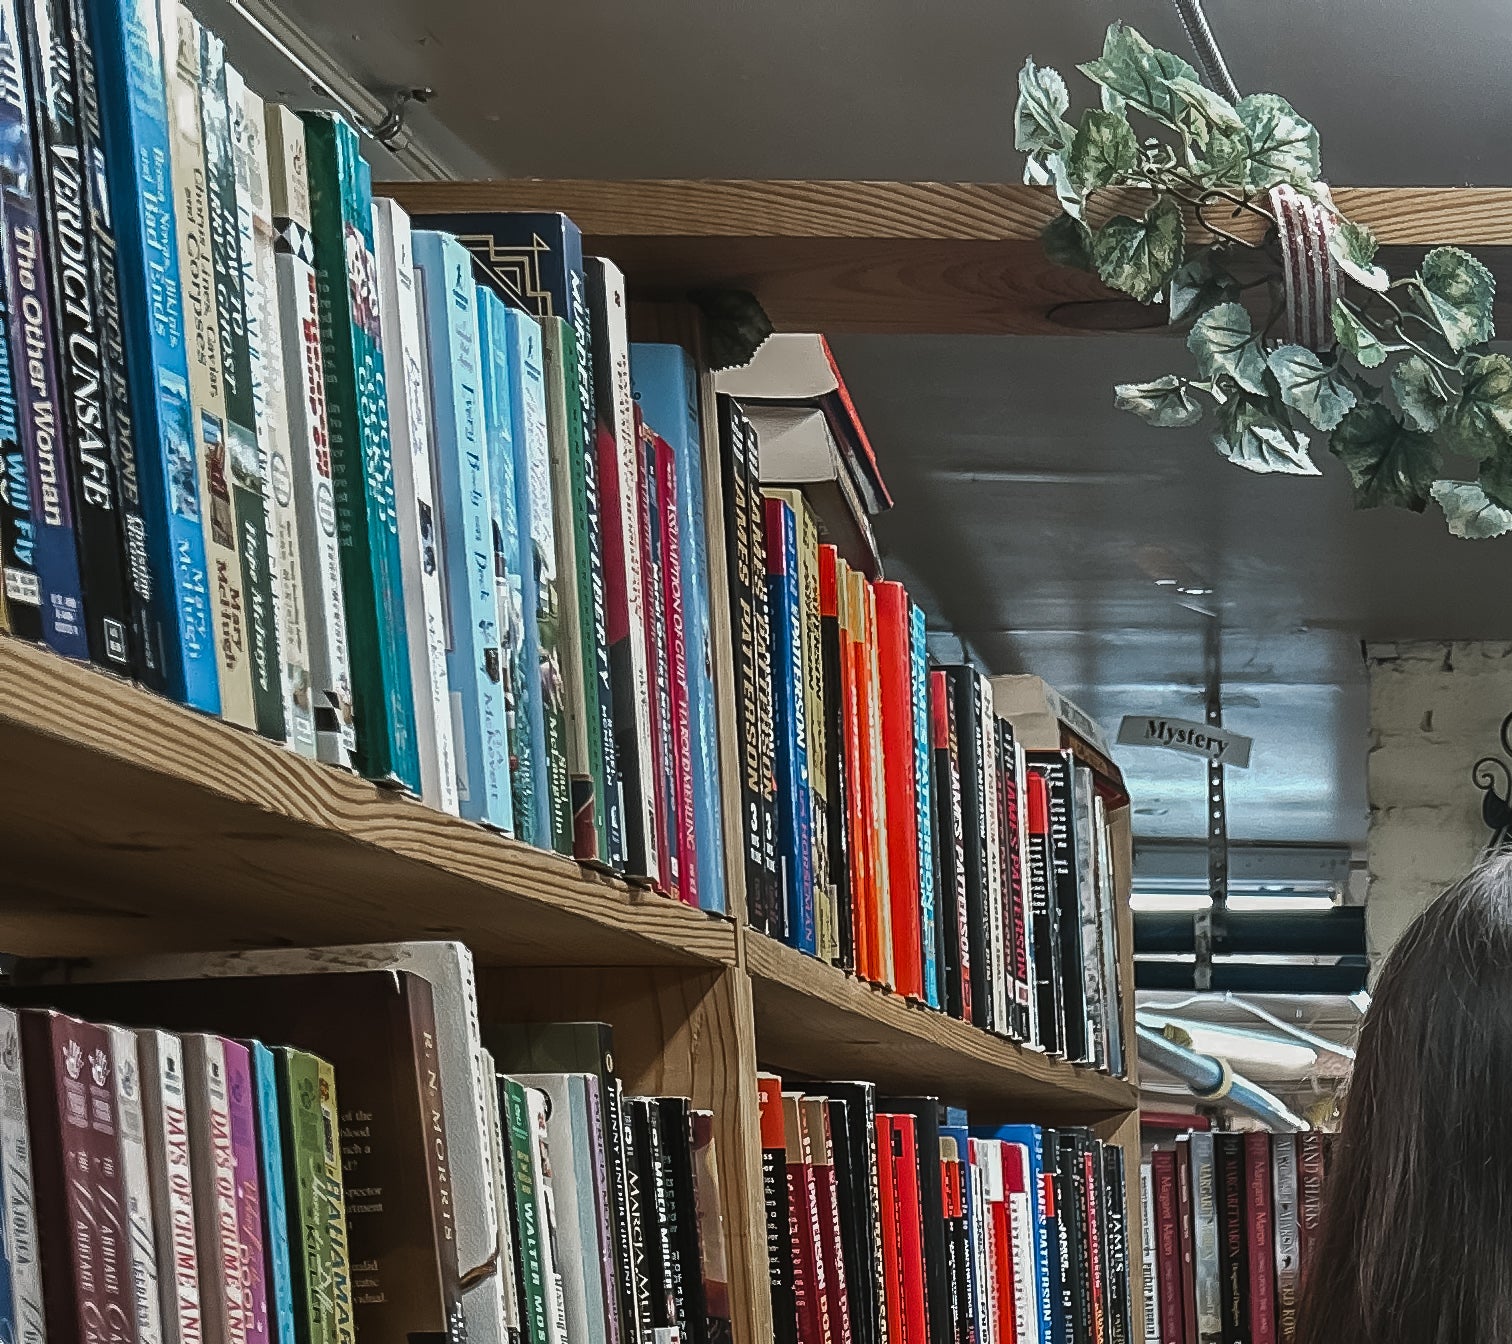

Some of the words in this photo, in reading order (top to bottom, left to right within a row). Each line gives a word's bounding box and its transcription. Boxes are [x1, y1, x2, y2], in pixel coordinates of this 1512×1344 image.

[14, 226, 39, 291] The
[50, 144, 97, 332] VERDICT
[22, 295, 49, 397] Other
[69, 333, 113, 510] UNSAFE
[6, 454, 31, 511] Will
[32, 401, 63, 526] Woman
[12, 520, 34, 565] Fly
[733, 466, 750, 586] JAMES
[738, 598, 759, 793] PATTERSON
[1144, 720, 1229, 759] Mystery
[166, 1105, 187, 1166] DAYS
[1302, 1135, 1320, 1174] SAND
[172, 1174, 190, 1208] OF
[1302, 1177, 1320, 1229] SHARKS
[175, 1209, 195, 1289] CRIME
[524, 1202, 540, 1286] WALTER
